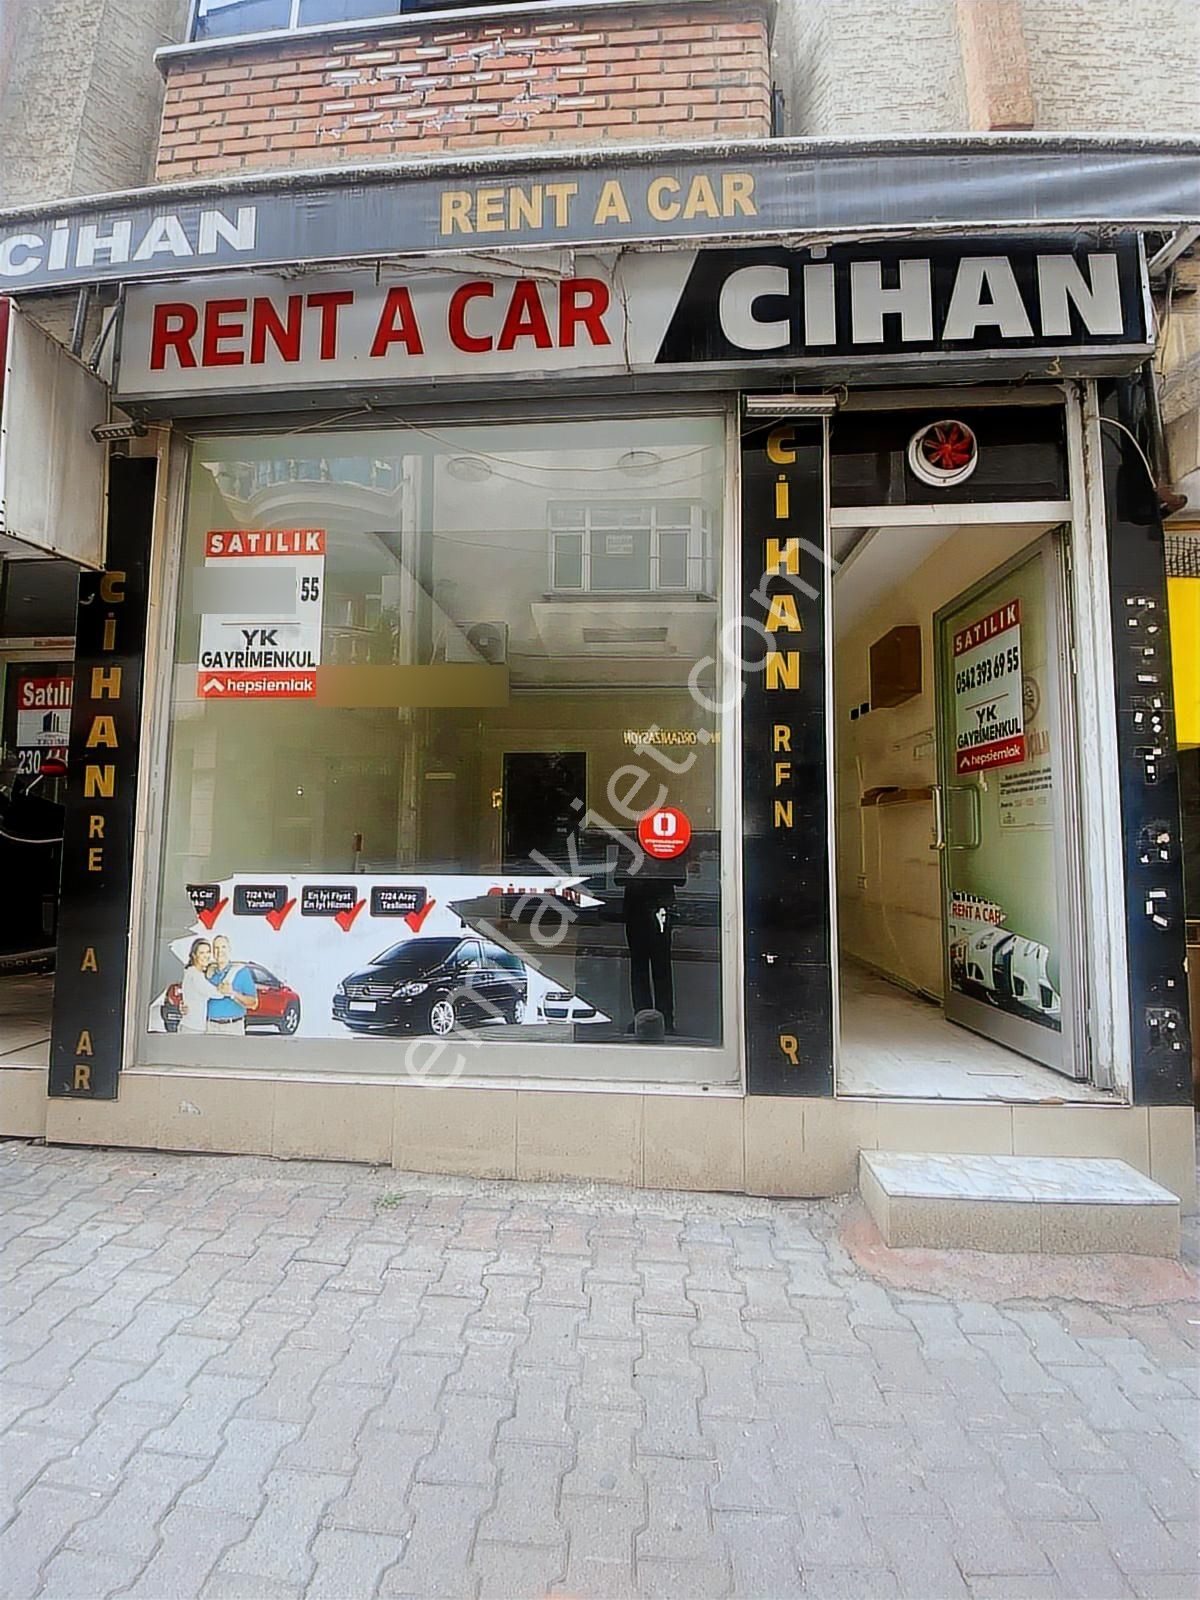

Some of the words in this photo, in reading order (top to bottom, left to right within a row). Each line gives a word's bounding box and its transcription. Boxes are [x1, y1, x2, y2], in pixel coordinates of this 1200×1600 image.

[440, 183, 578, 235] RENT
[594, 180, 631, 225] A
[647, 172, 758, 219] CAR
[0, 206, 256, 277] CİHAN
[150, 289, 354, 371] RENT
[369, 285, 425, 358] A
[447, 277, 612, 353] CAR
[718, 245, 1124, 350] CİHAN
[210, 533, 321, 553] SATILIK
[764, 427, 802, 690] CİHAN
[301, 576, 319, 602] 55
[241, 629, 278, 646] YK
[955, 603, 1016, 652] SATILIK
[201, 646, 316, 668] GAYRİMENKUL
[976, 658, 992, 687] 393
[1007, 646, 1019, 674] 55
[22, 680, 73, 706] Satılı
[83, 571, 127, 798] CİHAN
[226, 677, 313, 694] hepsiemlak
[976, 704, 998, 724] YK
[957, 717, 1022, 748] GAYRİMENKUL
[971, 743, 1021, 766] hepsiemlak
